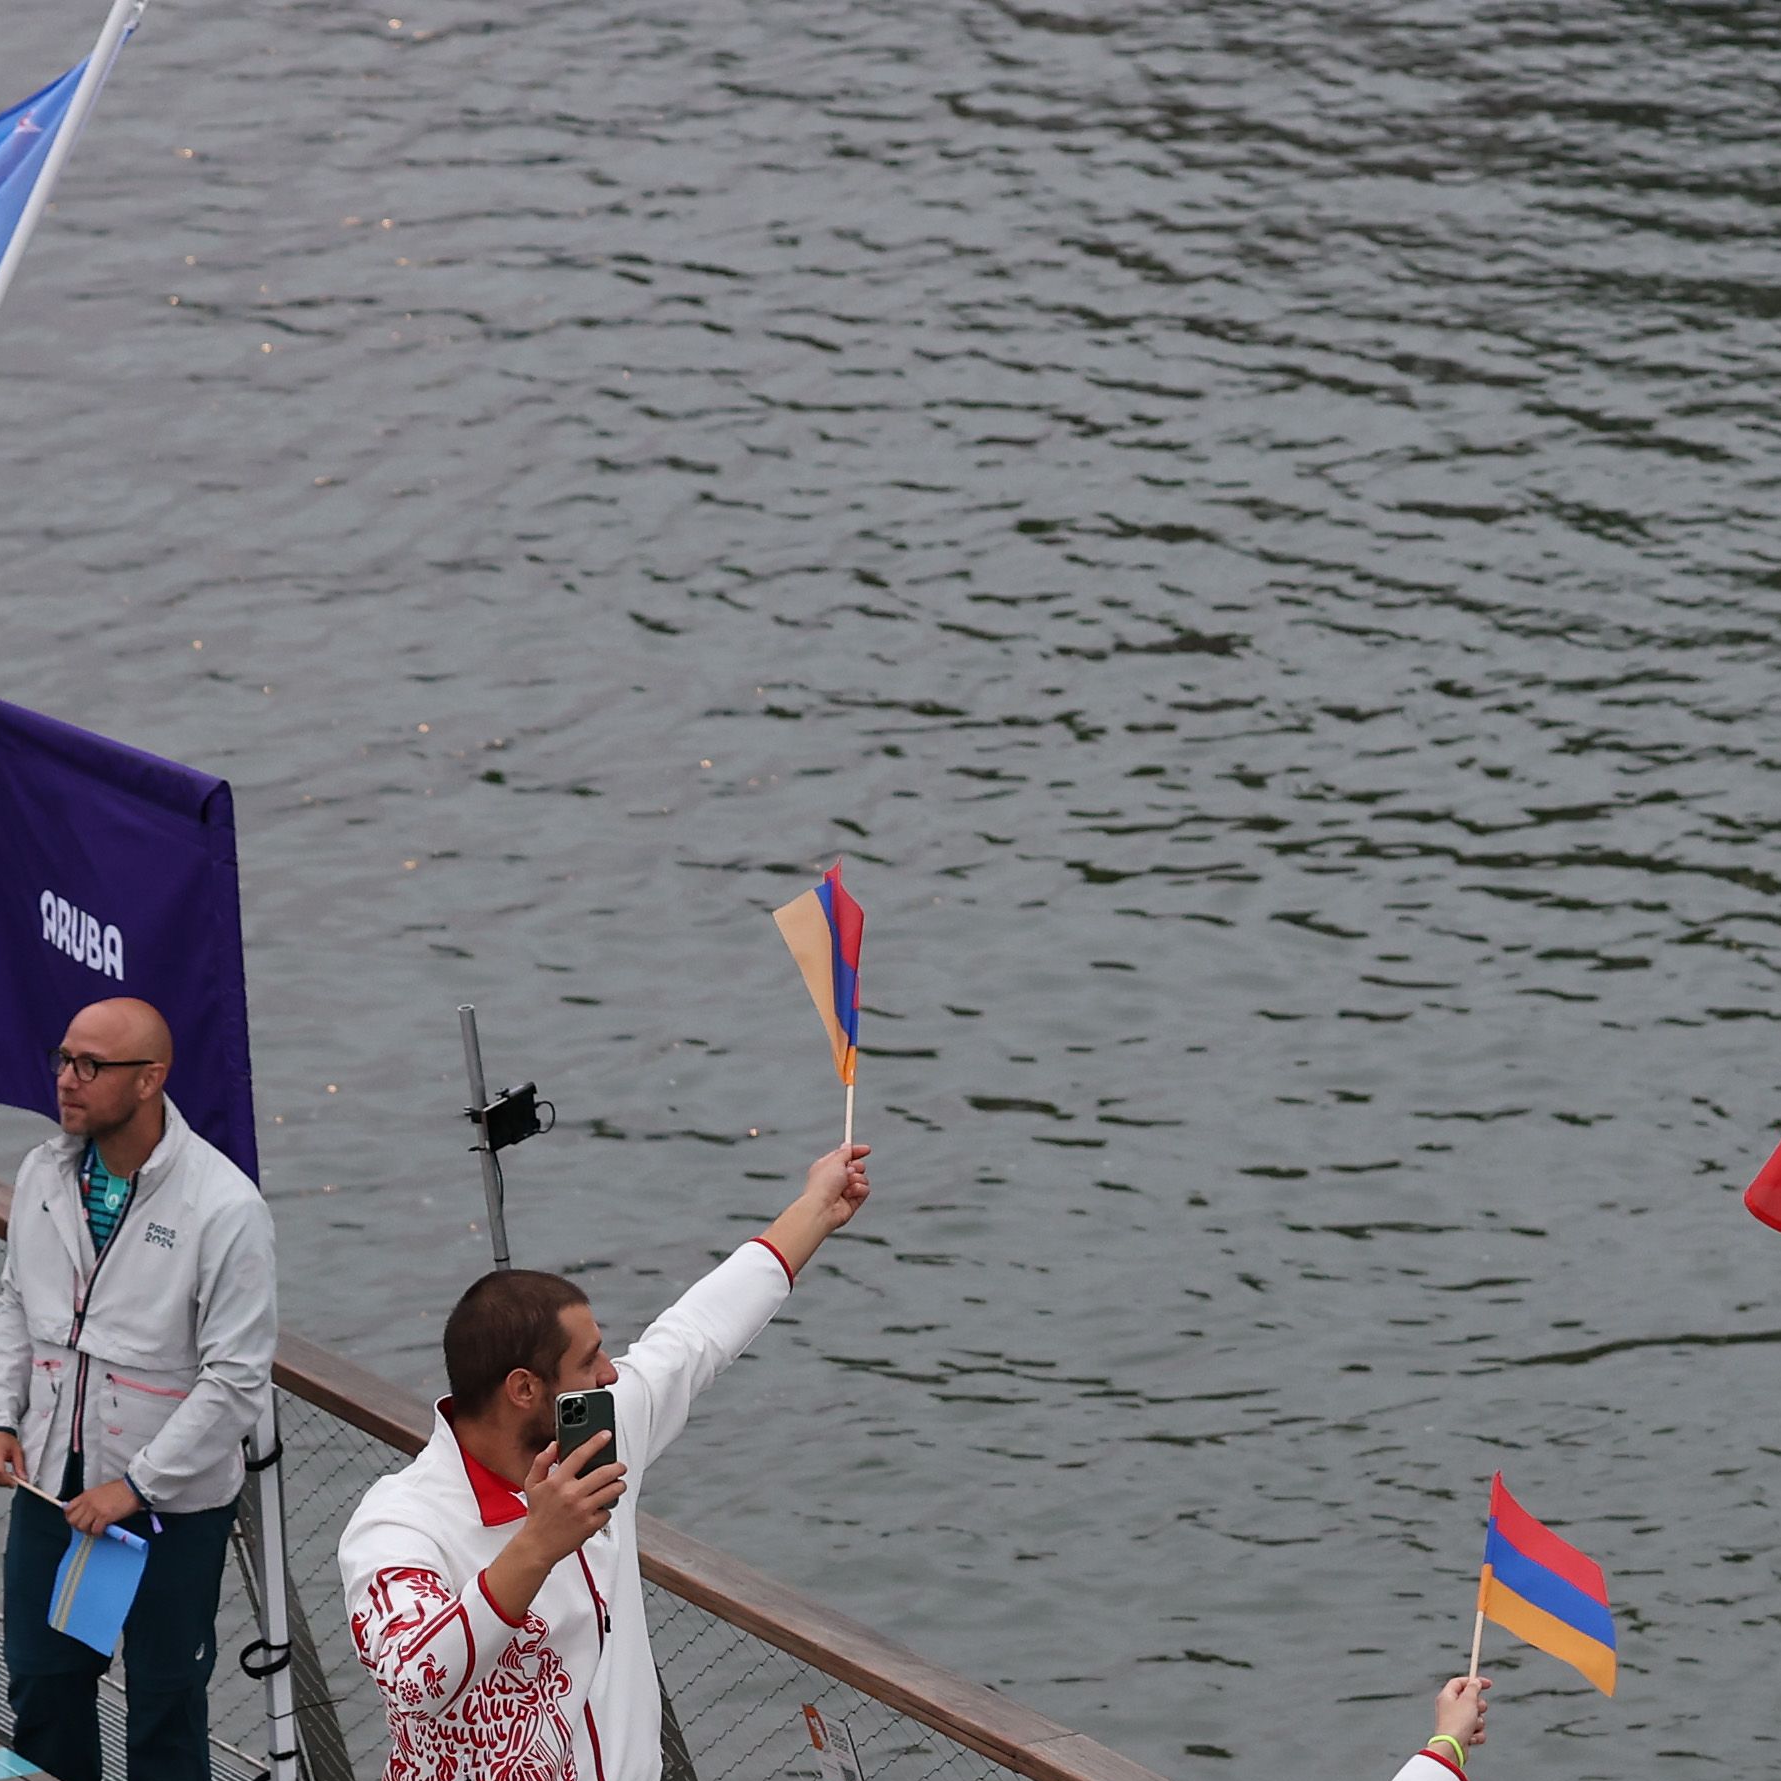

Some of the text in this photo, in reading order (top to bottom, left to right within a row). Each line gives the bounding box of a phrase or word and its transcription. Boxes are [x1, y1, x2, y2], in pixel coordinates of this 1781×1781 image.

[40, 890, 124, 981] ARUBA
[148, 1222, 177, 1239] PARIS
[145, 1231, 174, 1250] 2024
